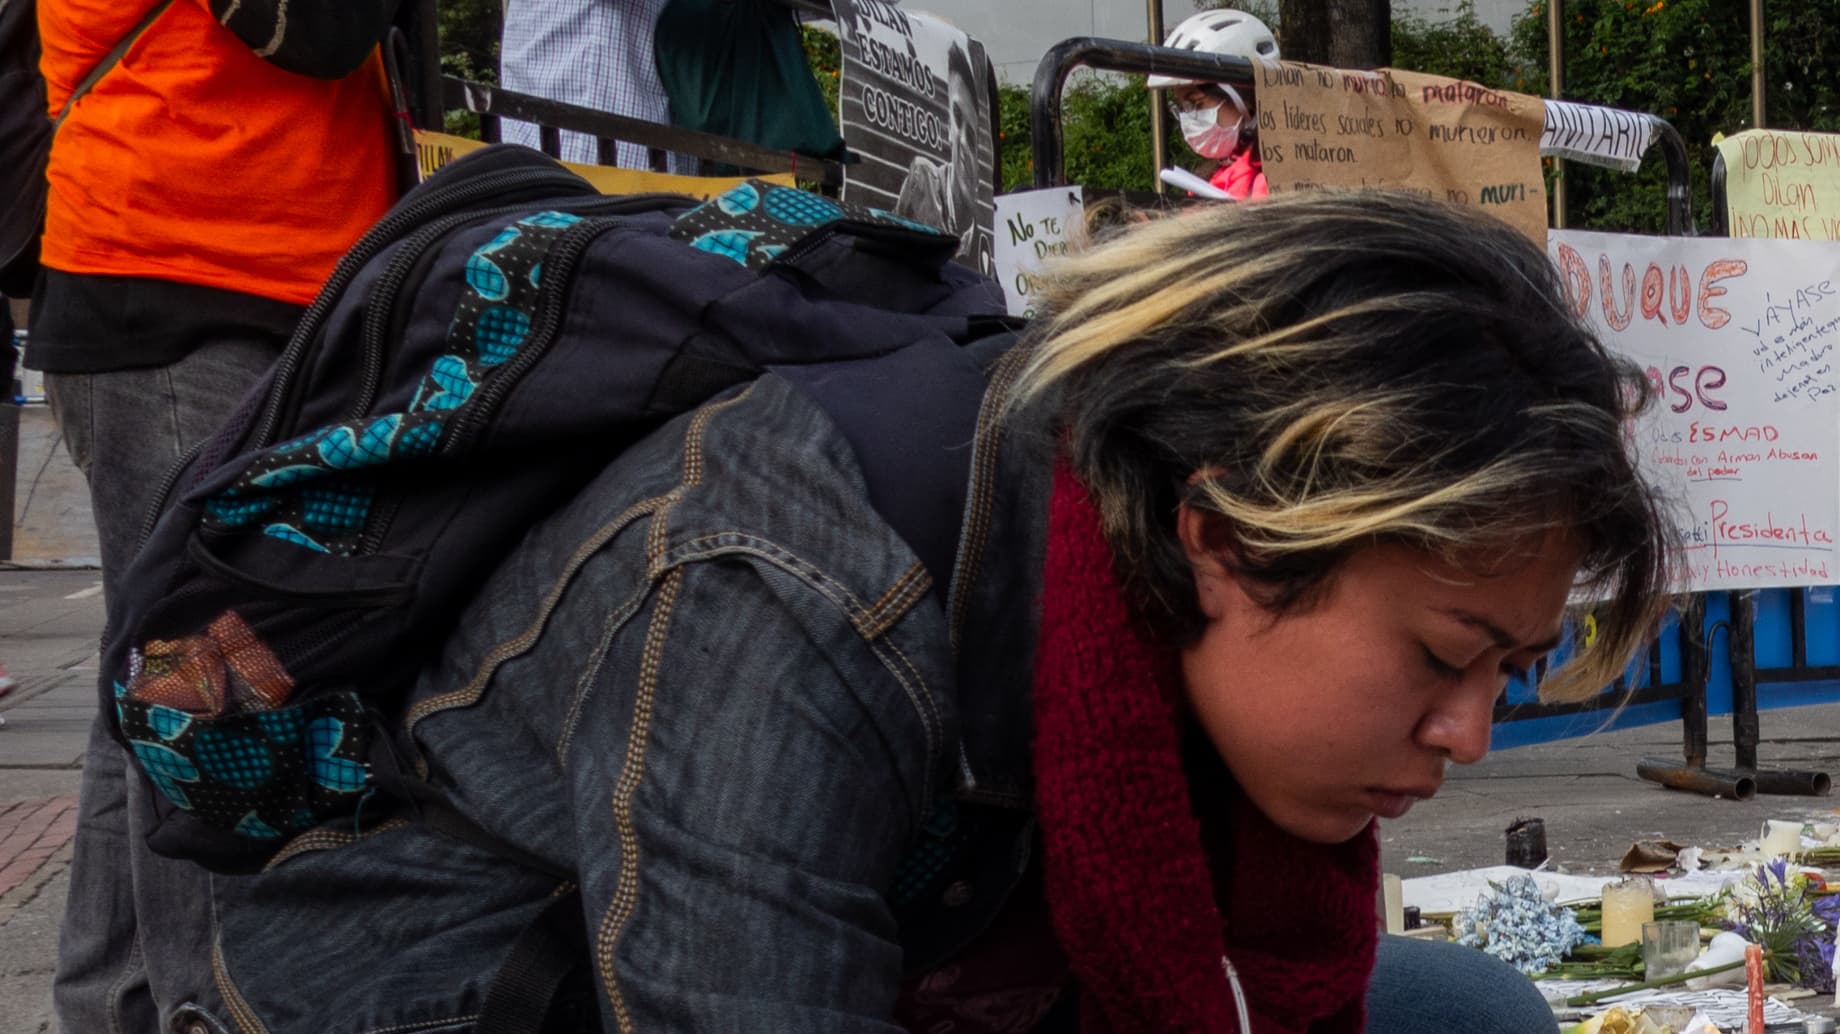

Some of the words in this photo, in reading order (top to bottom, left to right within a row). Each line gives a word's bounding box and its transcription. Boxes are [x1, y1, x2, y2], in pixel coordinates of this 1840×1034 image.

[861, 31, 936, 98] ESTAMOS
[862, 83, 944, 151] CONTIGO!
[1558, 240, 1749, 332] DUQUE
[1688, 420, 1780, 444] ESMAD
[1709, 499, 1834, 561] Presidenta
